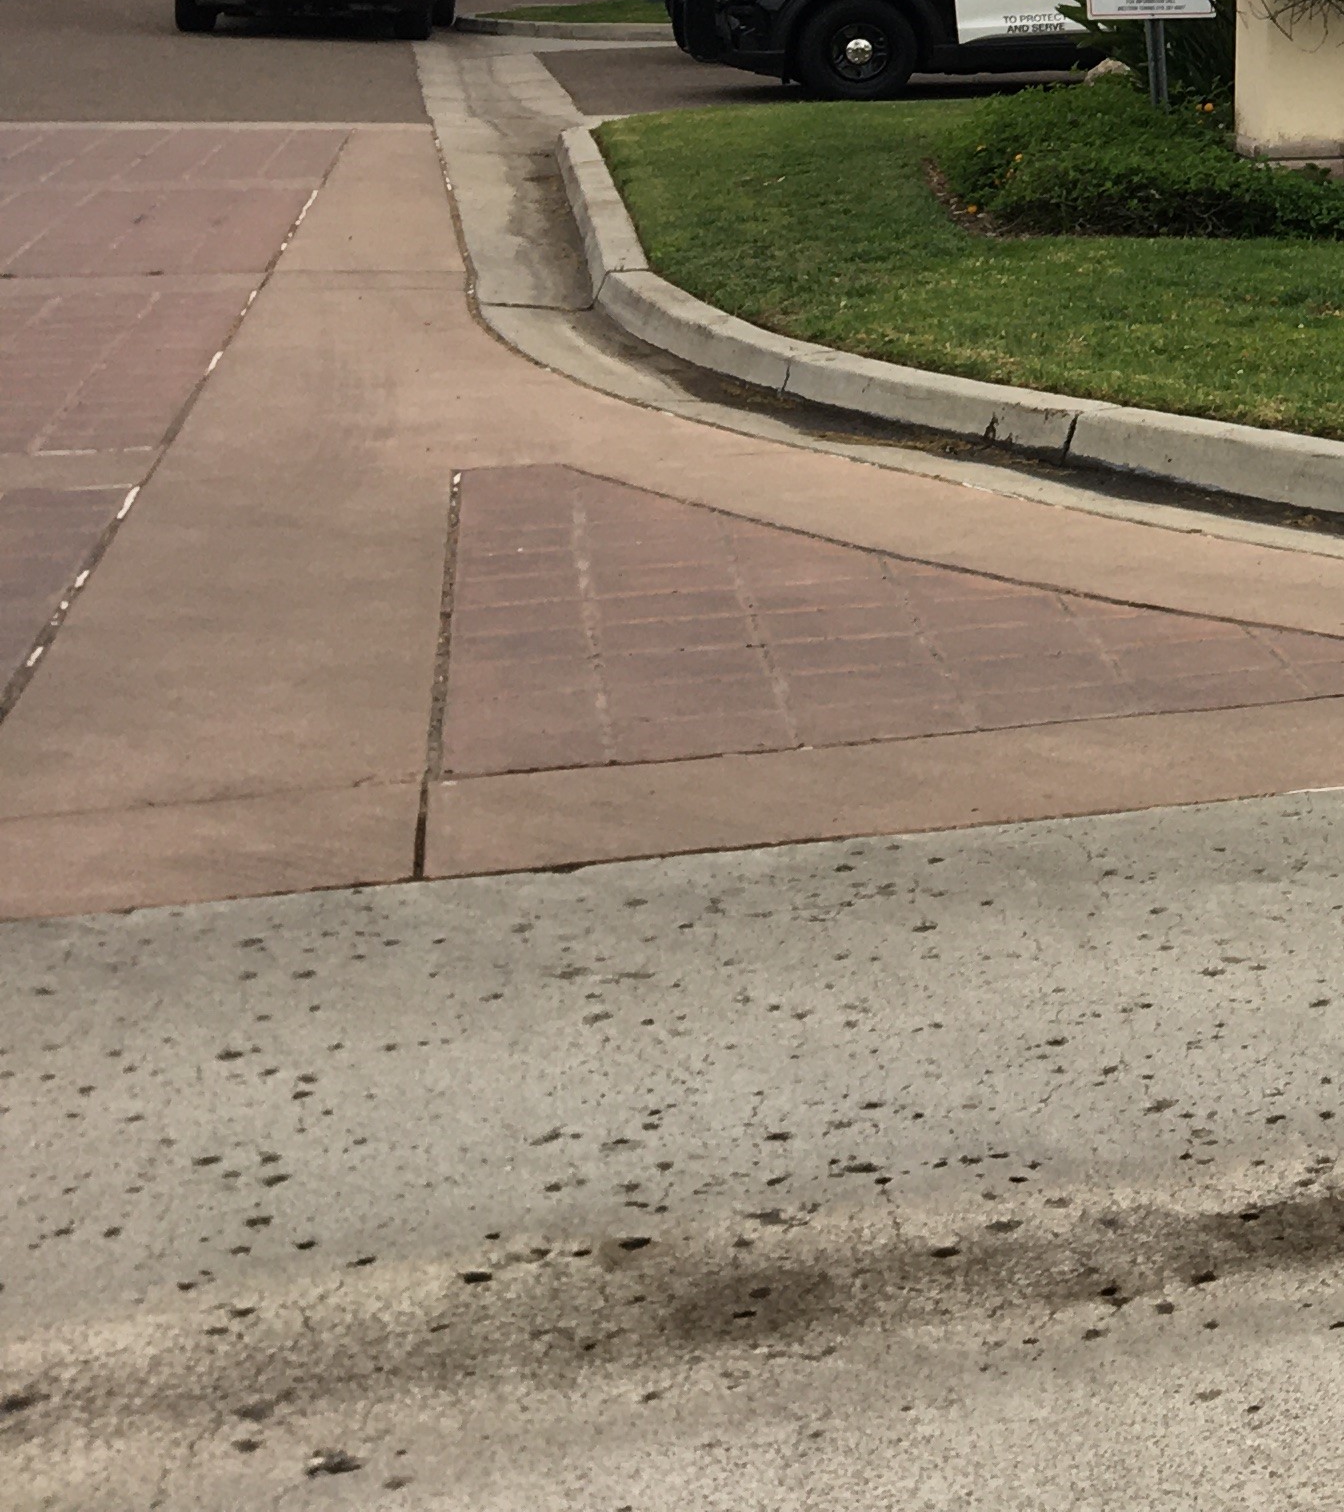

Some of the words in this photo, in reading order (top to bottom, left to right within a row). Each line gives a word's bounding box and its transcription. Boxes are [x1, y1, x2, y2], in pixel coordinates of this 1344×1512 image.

[1003, 15, 1017, 24] TO
[1007, 24, 1029, 33] AND
[1032, 22, 1065, 32] SERVE
